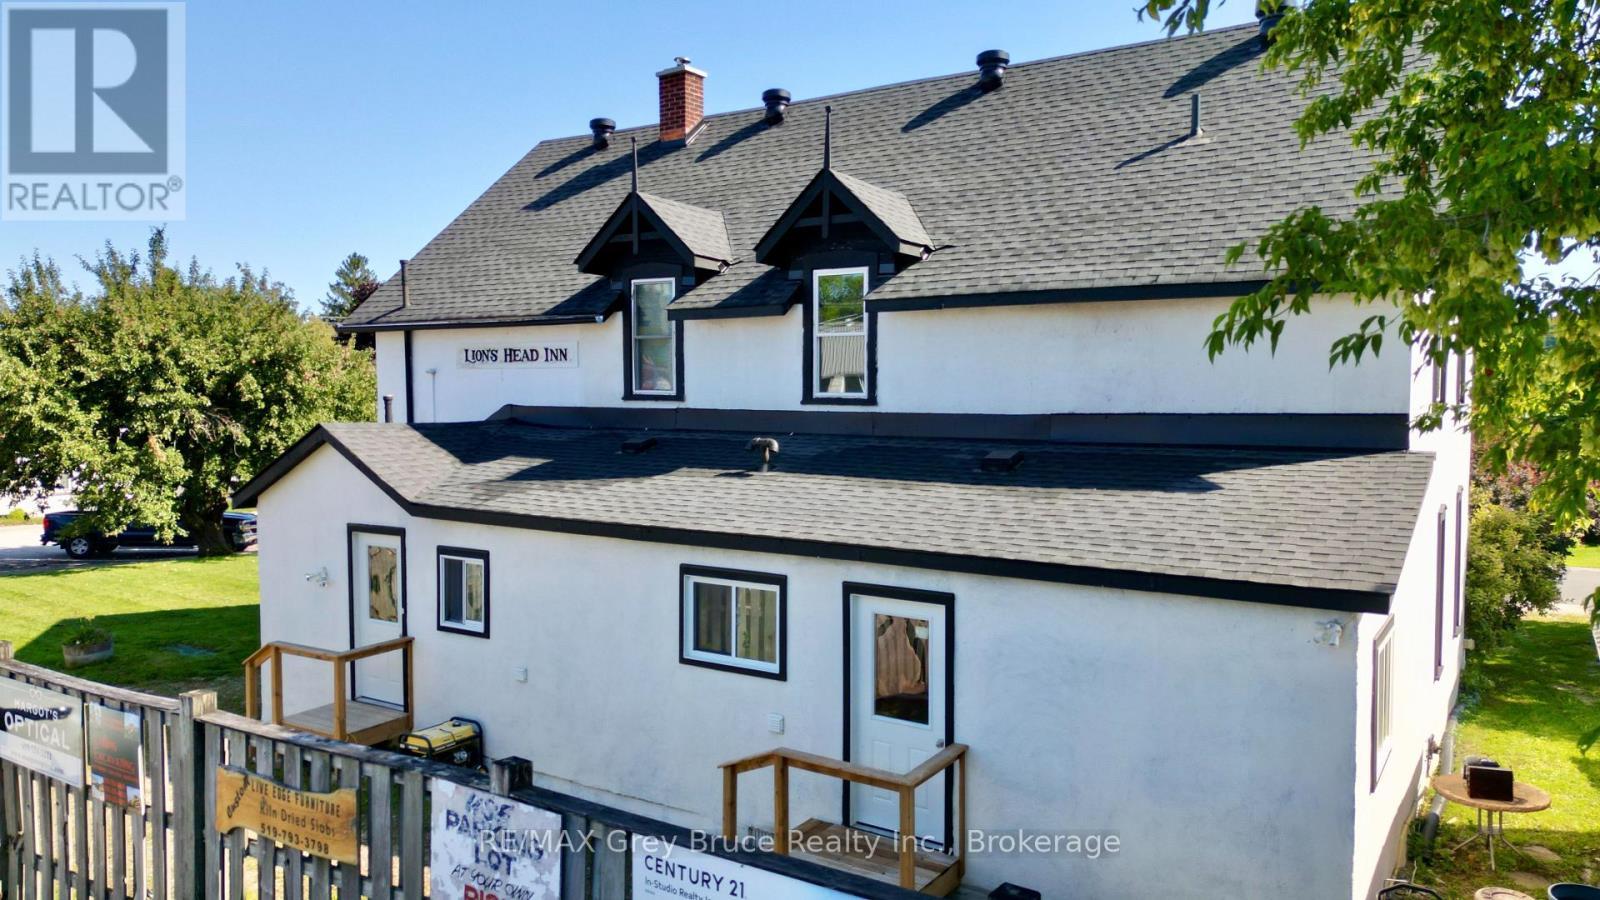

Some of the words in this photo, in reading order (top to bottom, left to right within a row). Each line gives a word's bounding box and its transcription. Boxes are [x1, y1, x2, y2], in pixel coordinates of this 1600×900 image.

[503, 348, 540, 363] HEAD
[544, 347, 568, 362] INN
[4, 711, 71, 750] OPTICAL
[251, 780, 269, 798] LIVE
[272, 789, 291, 804] EDGE
[294, 792, 341, 818] FURNITURE
[280, 808, 307, 829] Dried
[260, 823, 329, 855] 519-793-3798
[475, 842, 517, 876] LOT
[644, 855, 724, 892] CENTURY
[729, 879, 745, 899] 21
[644, 876, 677, 896] In-Studio
